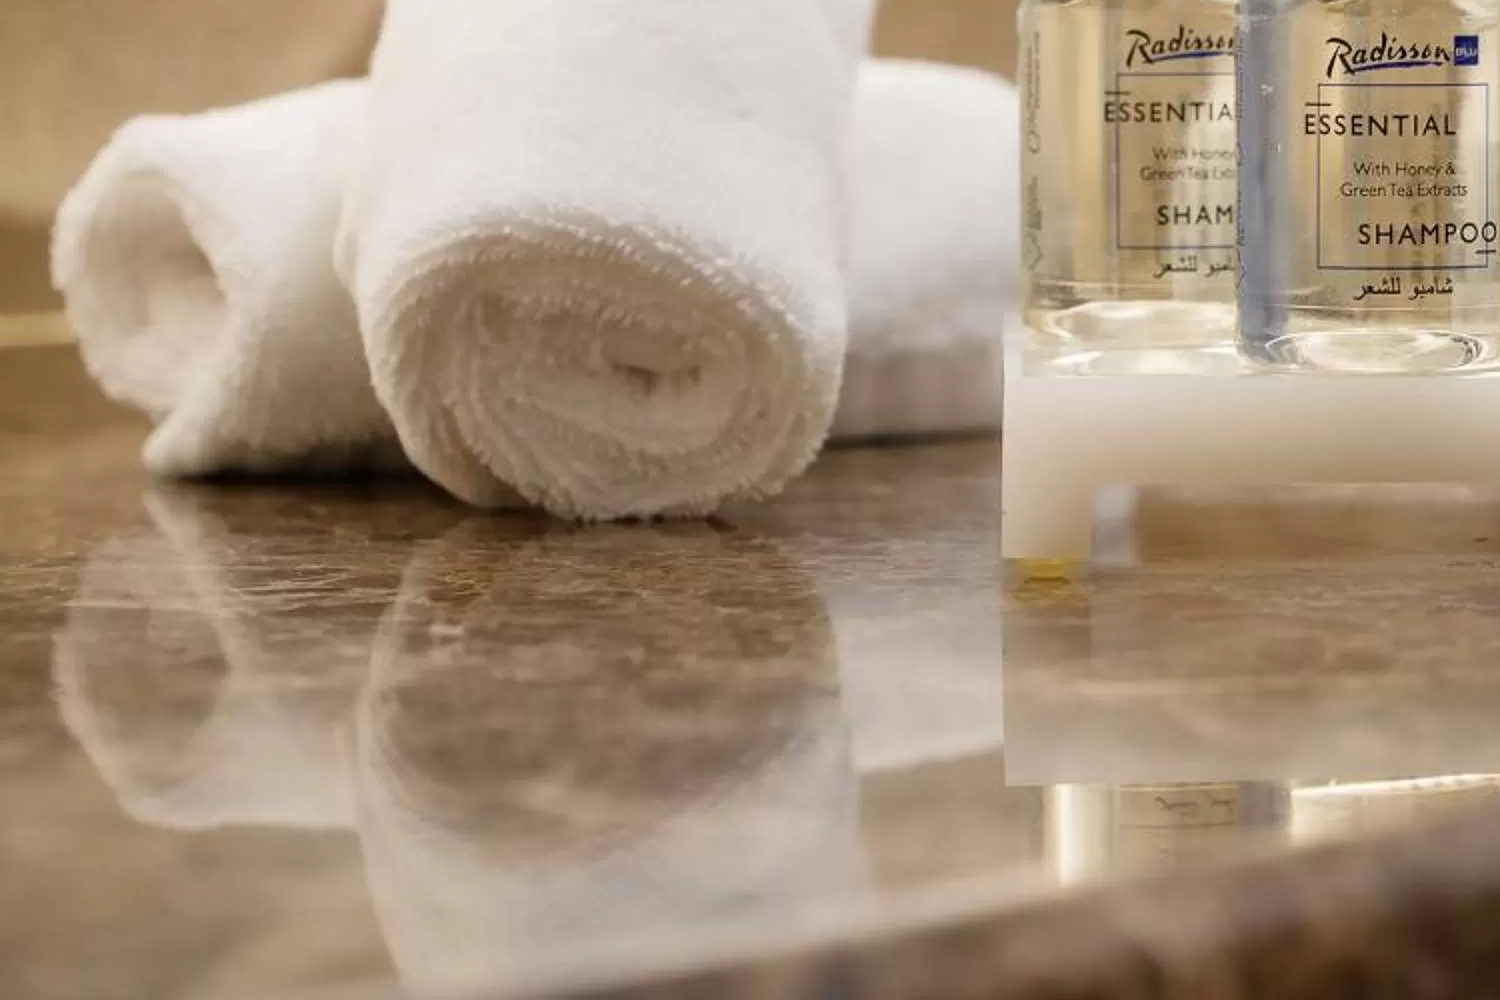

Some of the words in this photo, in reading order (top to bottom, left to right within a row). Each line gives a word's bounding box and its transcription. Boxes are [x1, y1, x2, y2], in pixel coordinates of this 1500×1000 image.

[1325, 32, 1451, 79] Radisson
[1104, 102, 1234, 123] ESSENTIA
[1304, 114, 1457, 136] ESSENTIAL
[1353, 161, 1391, 176] With
[1395, 162, 1441, 178] Honey
[1445, 161, 1457, 176] &
[1340, 181, 1387, 197] Green
[1390, 182, 1414, 197] Tea
[1417, 183, 1468, 197] Extracts
[1157, 204, 1234, 226] SHAM
[1358, 221, 1497, 245] SHAMPOO
[1353, 276, 1401, 300] للشعر
[1408, 277, 1454, 300] شامبو
